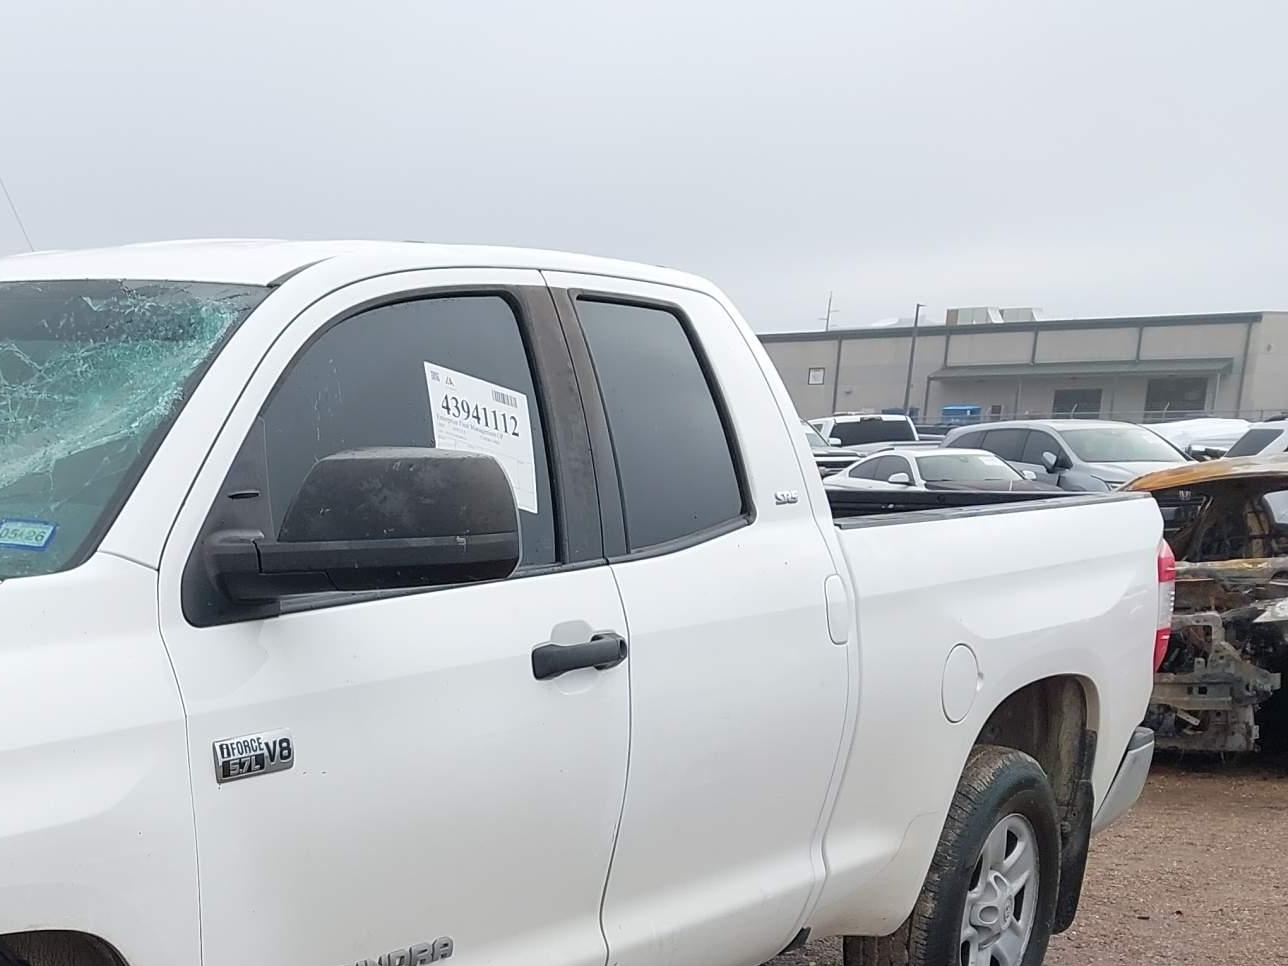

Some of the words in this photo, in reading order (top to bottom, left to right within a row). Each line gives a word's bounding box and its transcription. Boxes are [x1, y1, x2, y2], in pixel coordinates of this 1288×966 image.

[441, 393, 520, 437] 43941112
[264, 737, 292, 763] V8
[229, 755, 261, 776] 5.7L
